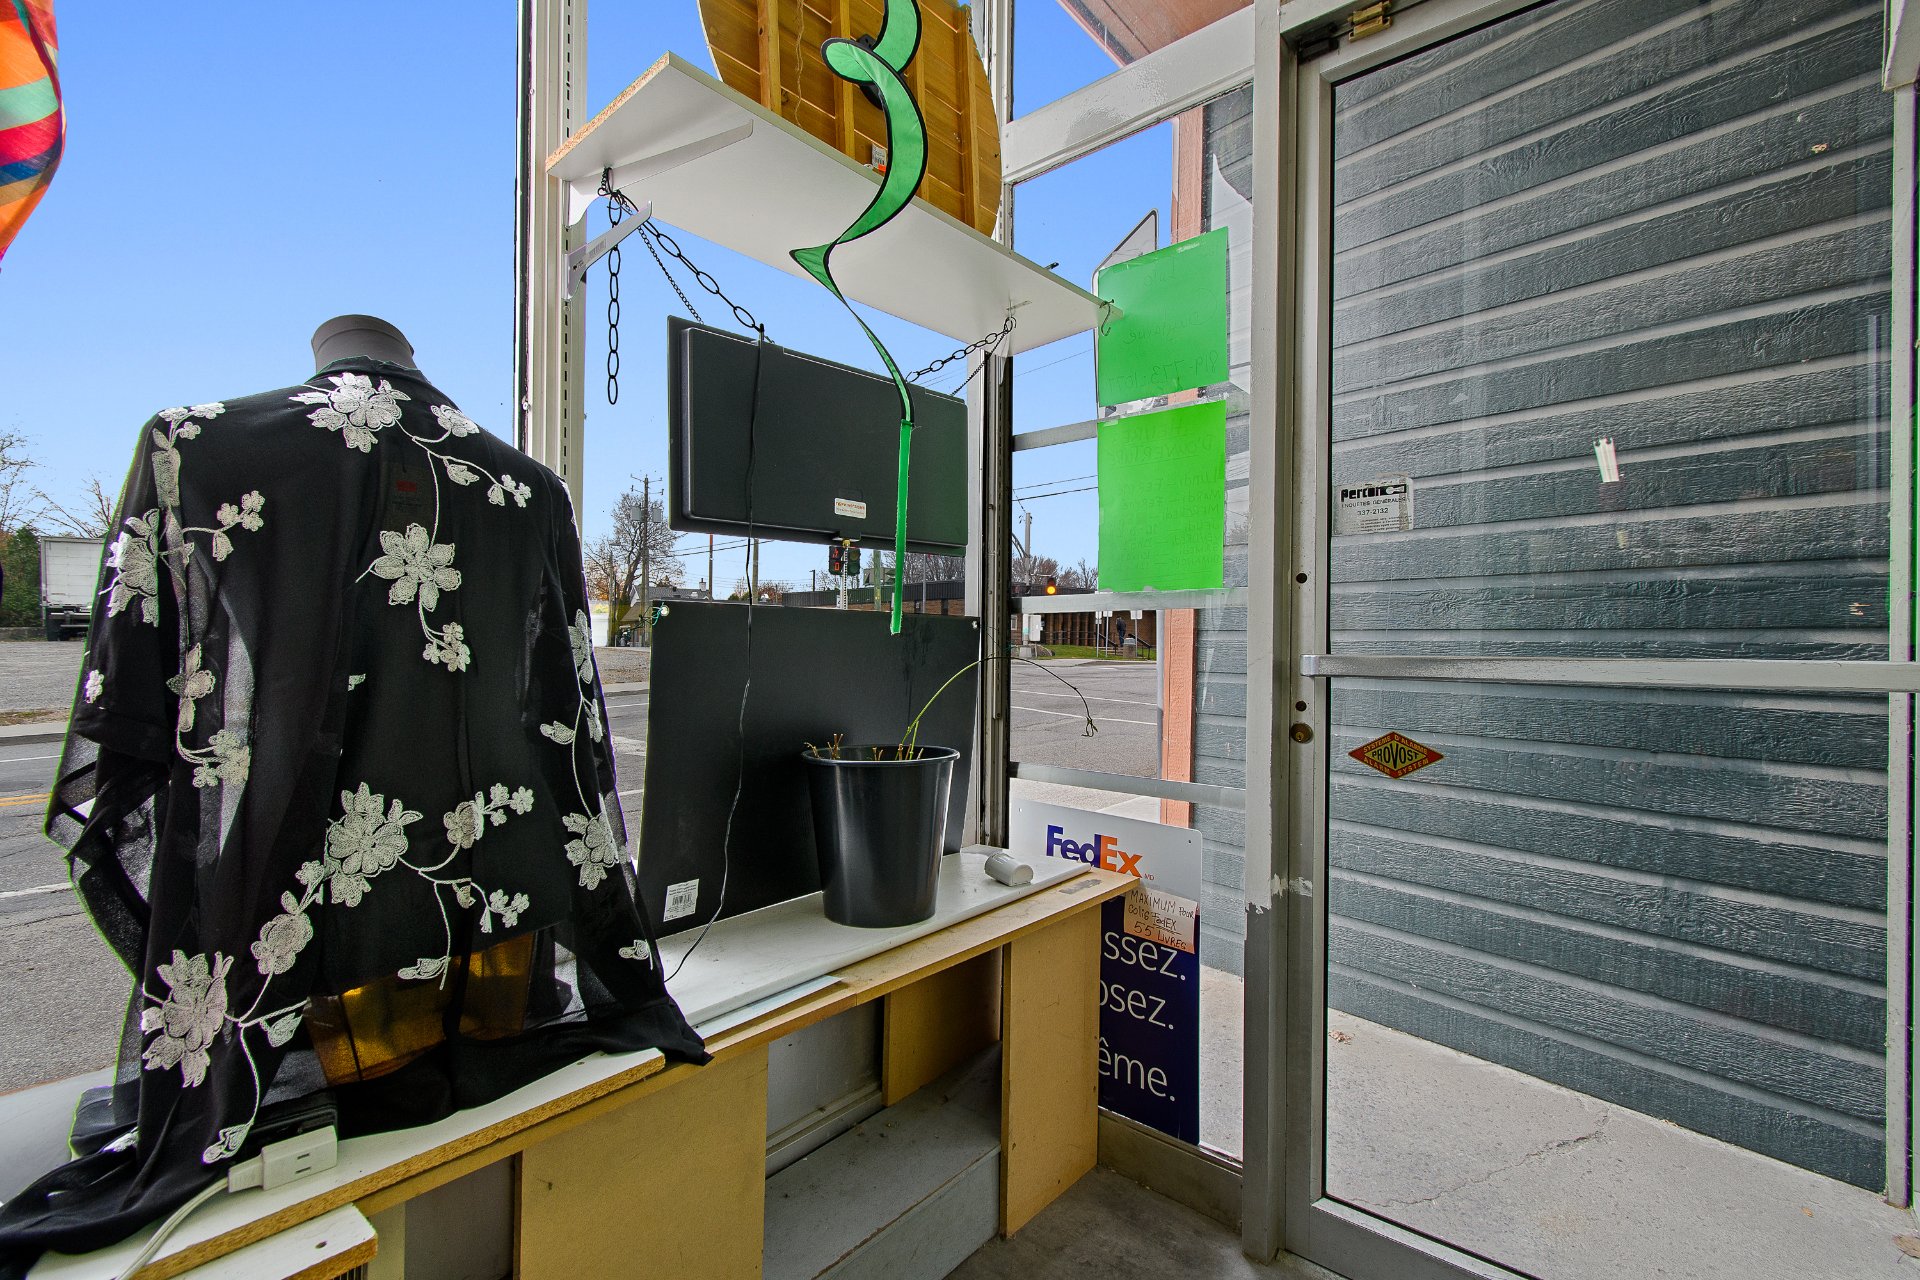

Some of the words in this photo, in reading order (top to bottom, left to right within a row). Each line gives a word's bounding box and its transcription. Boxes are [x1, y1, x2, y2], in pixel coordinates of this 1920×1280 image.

[1363, 756, 1391, 775] ALARM
[1397, 758, 1430, 776] SYSTEM
[1371, 743, 1420, 769] PROVOST
[1046, 824, 1144, 878] FedEx
[1134, 921, 1154, 937] 55
[1103, 931, 1186, 981] ssez.
